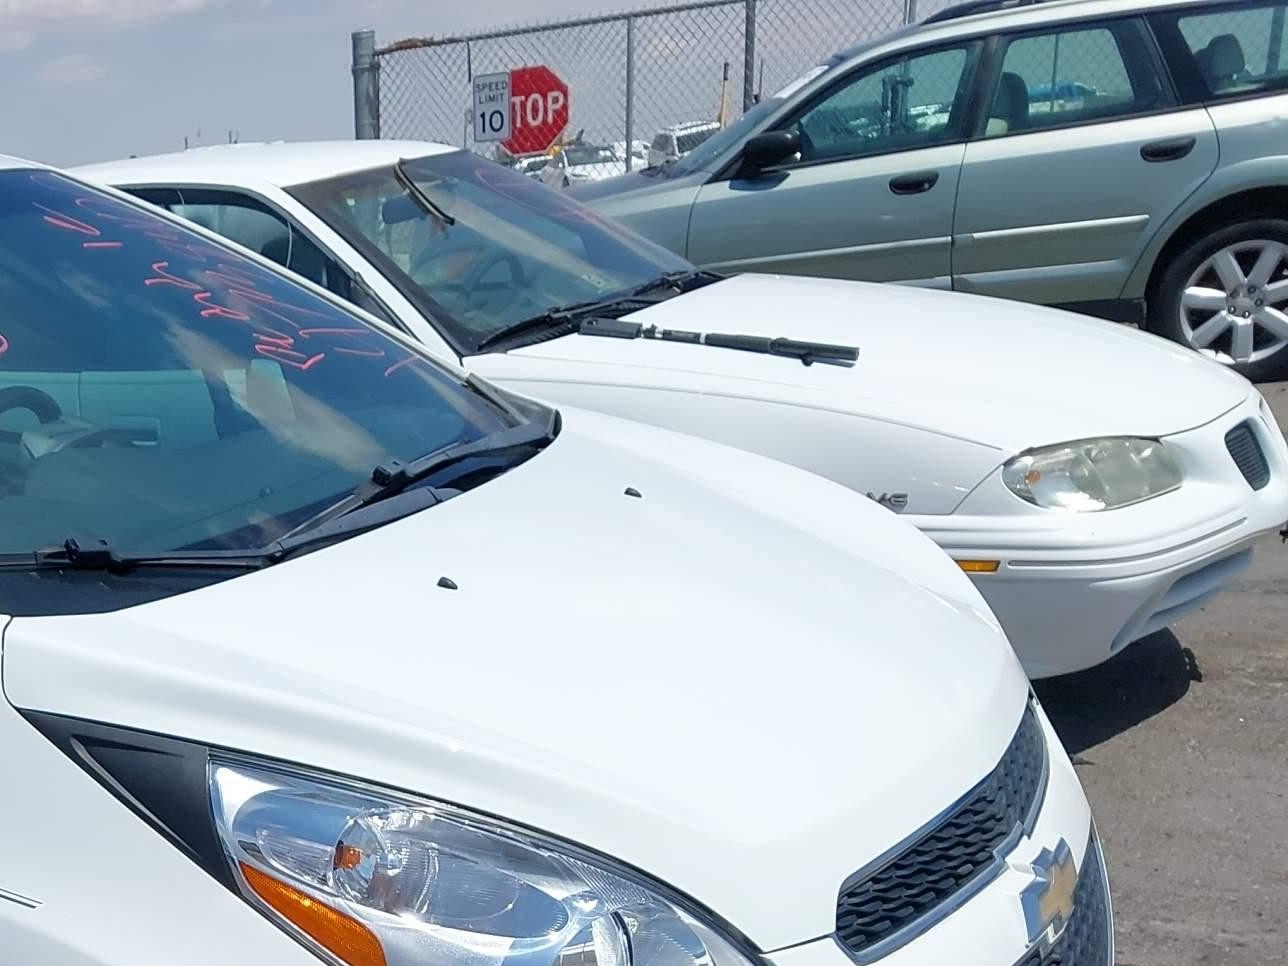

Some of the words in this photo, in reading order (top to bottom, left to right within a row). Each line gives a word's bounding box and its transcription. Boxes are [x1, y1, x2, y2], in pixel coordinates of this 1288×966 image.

[475, 81, 507, 93] SPEED
[478, 93, 505, 104] LIMIT
[511, 91, 564, 128] TOP
[479, 110, 504, 133] 10
